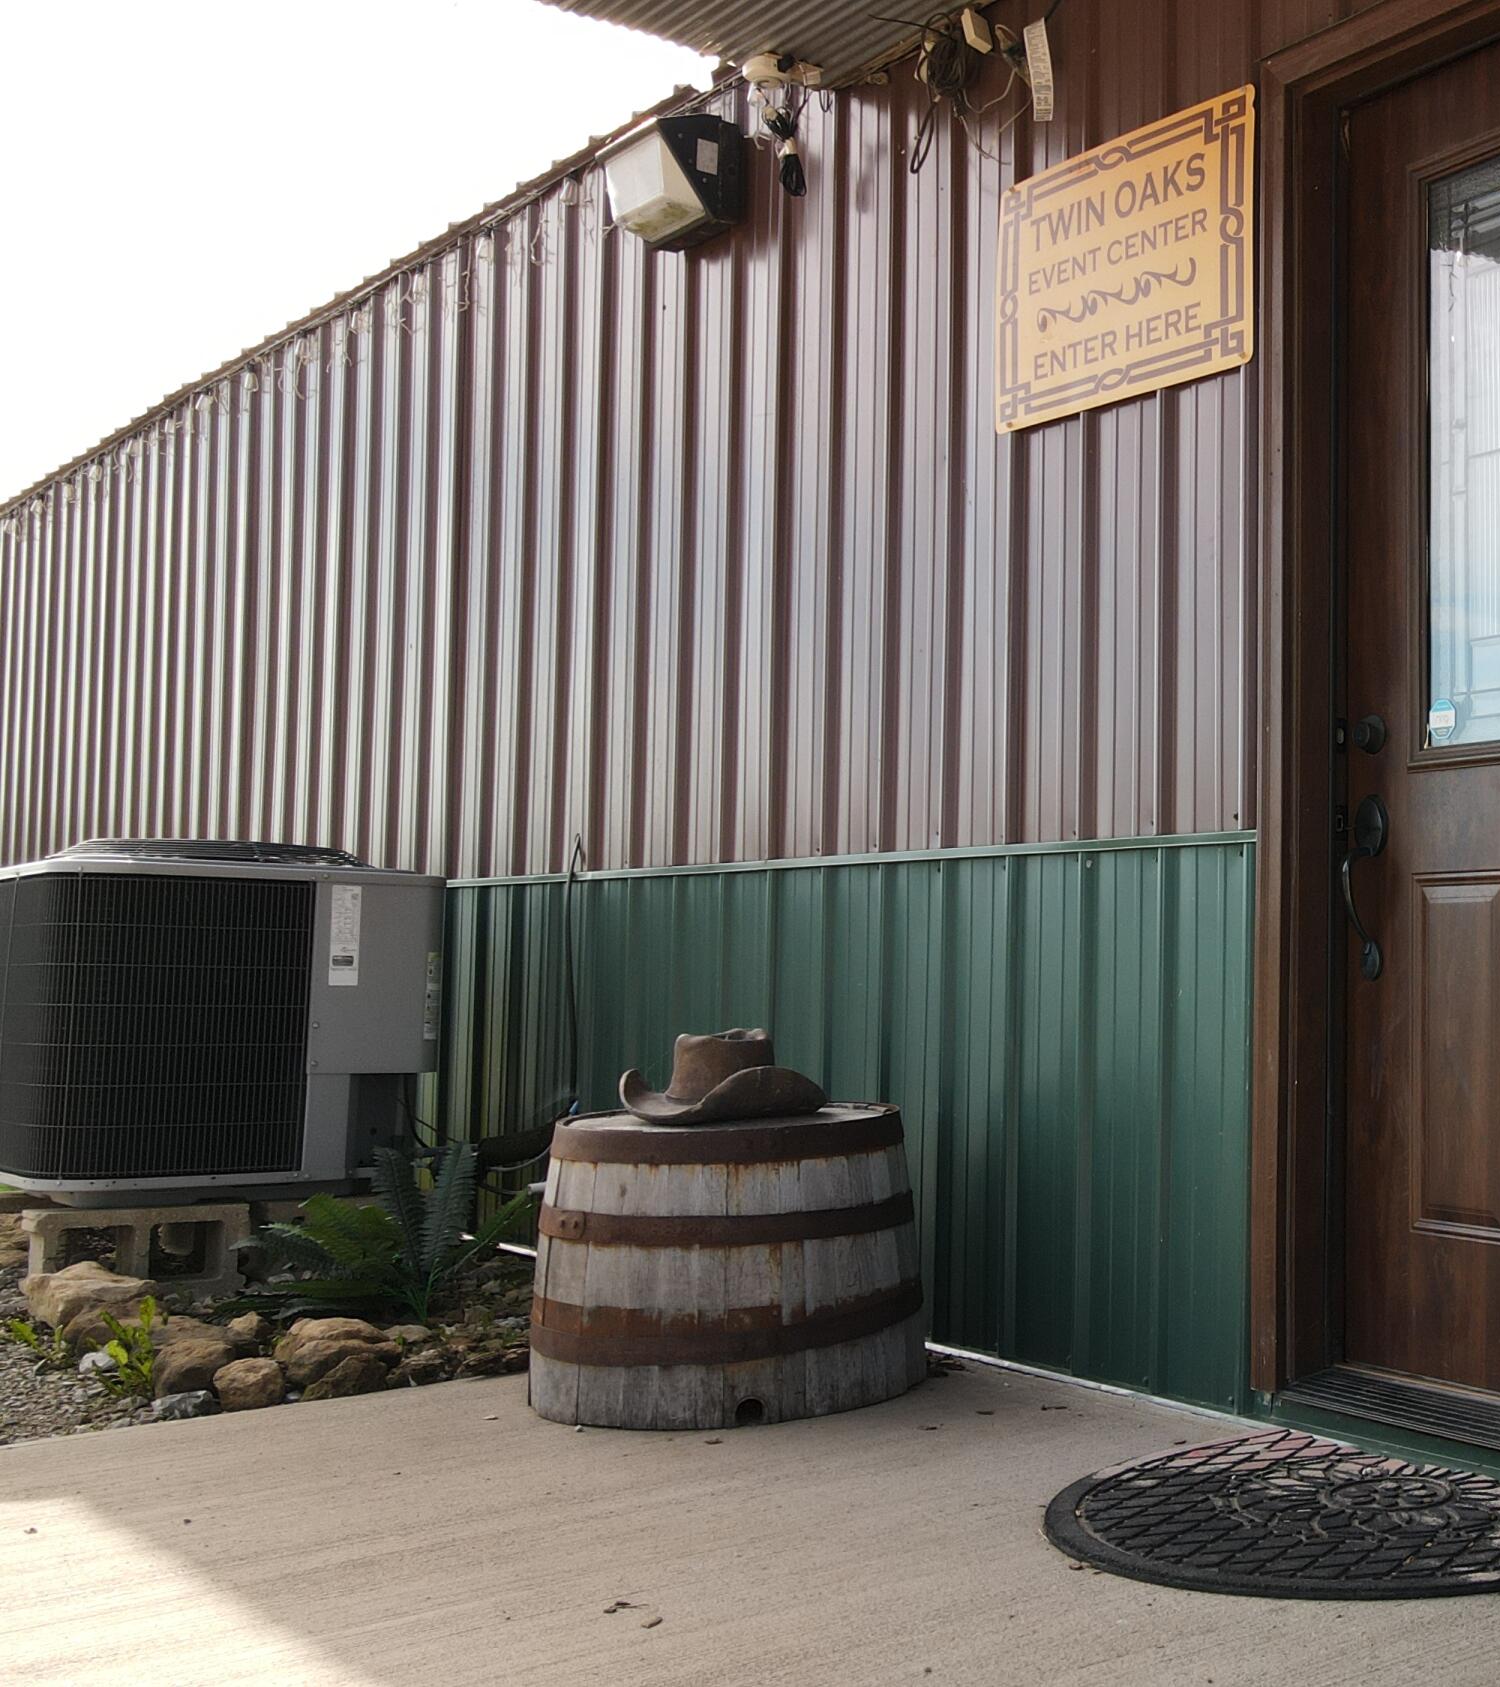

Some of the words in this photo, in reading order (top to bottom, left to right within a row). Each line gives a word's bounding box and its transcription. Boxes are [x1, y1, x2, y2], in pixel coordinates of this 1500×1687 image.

[1030, 190, 1106, 252] TWIN
[1115, 153, 1206, 219] OAKS
[1028, 246, 1102, 295] EVENT
[1107, 208, 1208, 266] CENTER
[1034, 330, 1117, 381] ENTER
[1125, 301, 1202, 351] HERE
